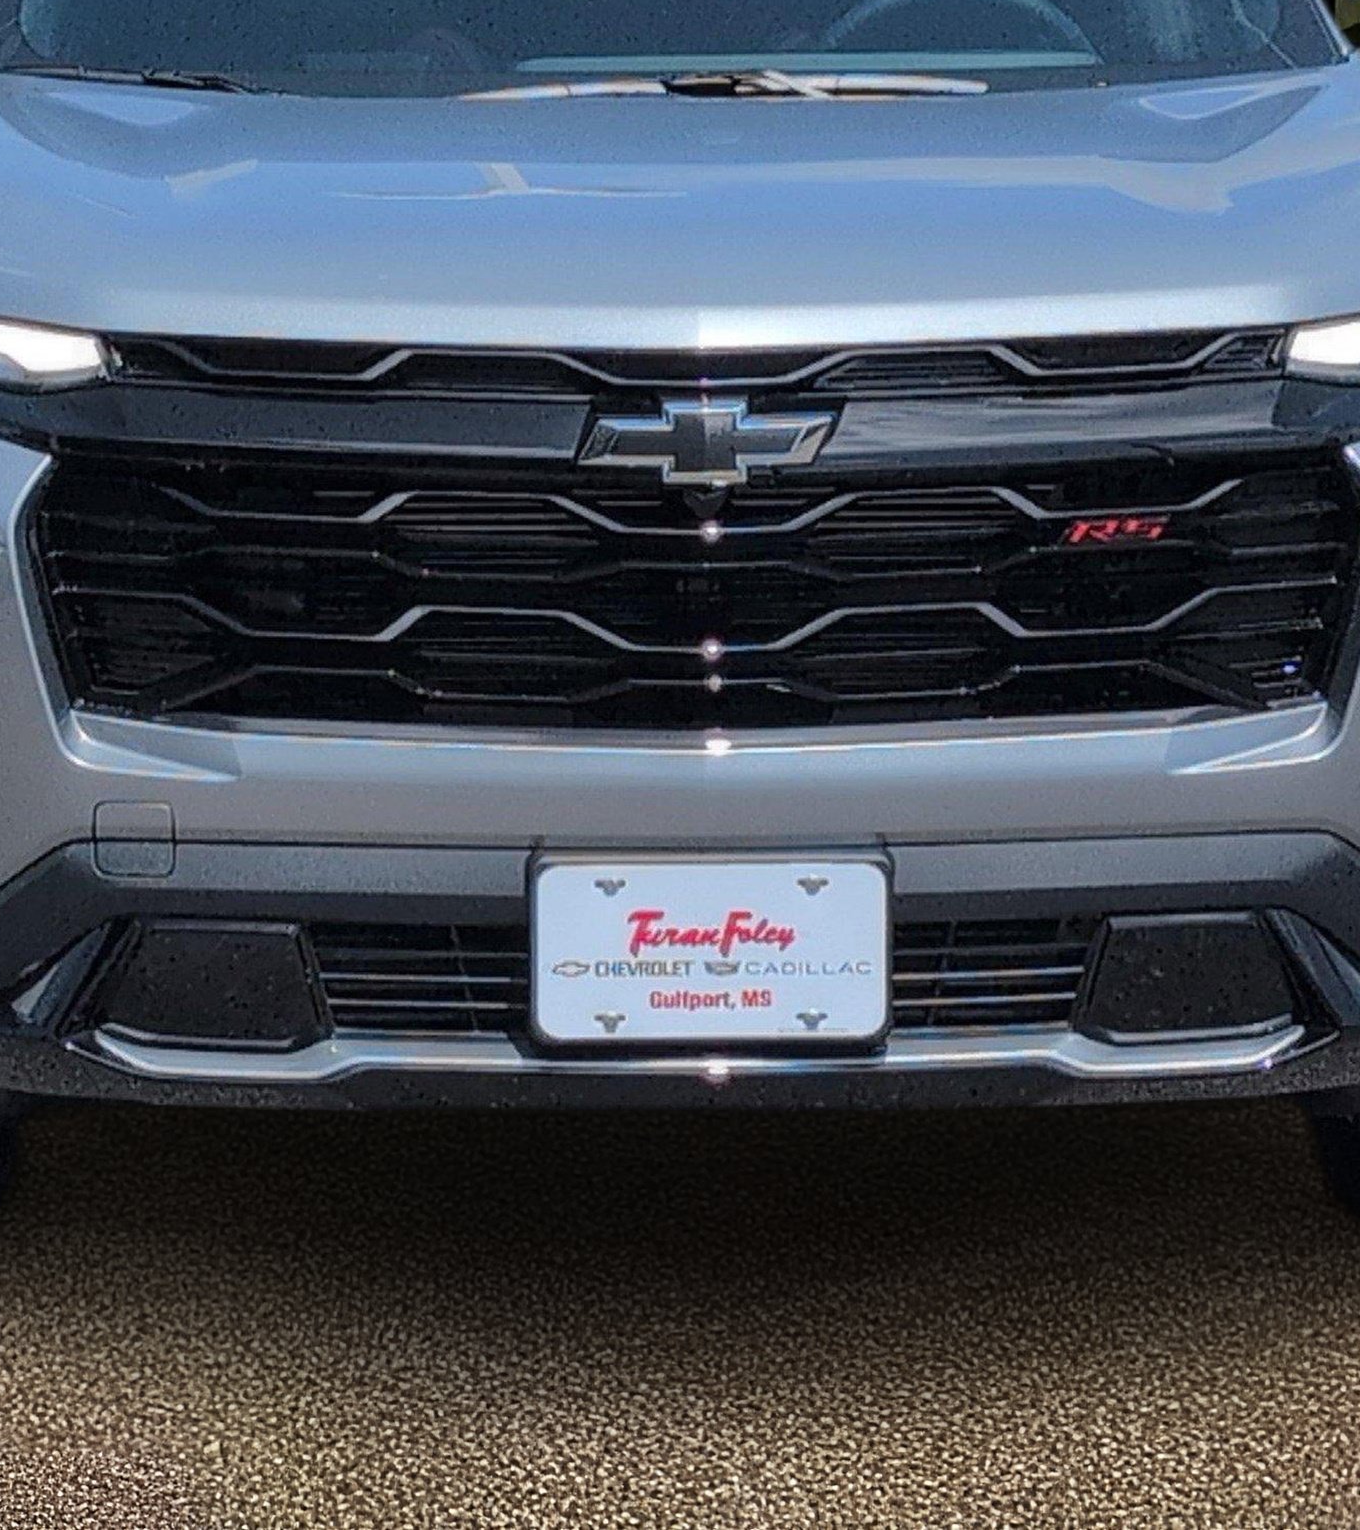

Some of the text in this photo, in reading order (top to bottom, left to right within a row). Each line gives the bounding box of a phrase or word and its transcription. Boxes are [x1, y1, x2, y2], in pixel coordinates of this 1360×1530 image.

[1067, 516, 1170, 544] RS
[594, 959, 695, 978] CHEVROLET
[743, 960, 873, 976] CADILLAC
[648, 989, 773, 1011] Gulfport, MS
